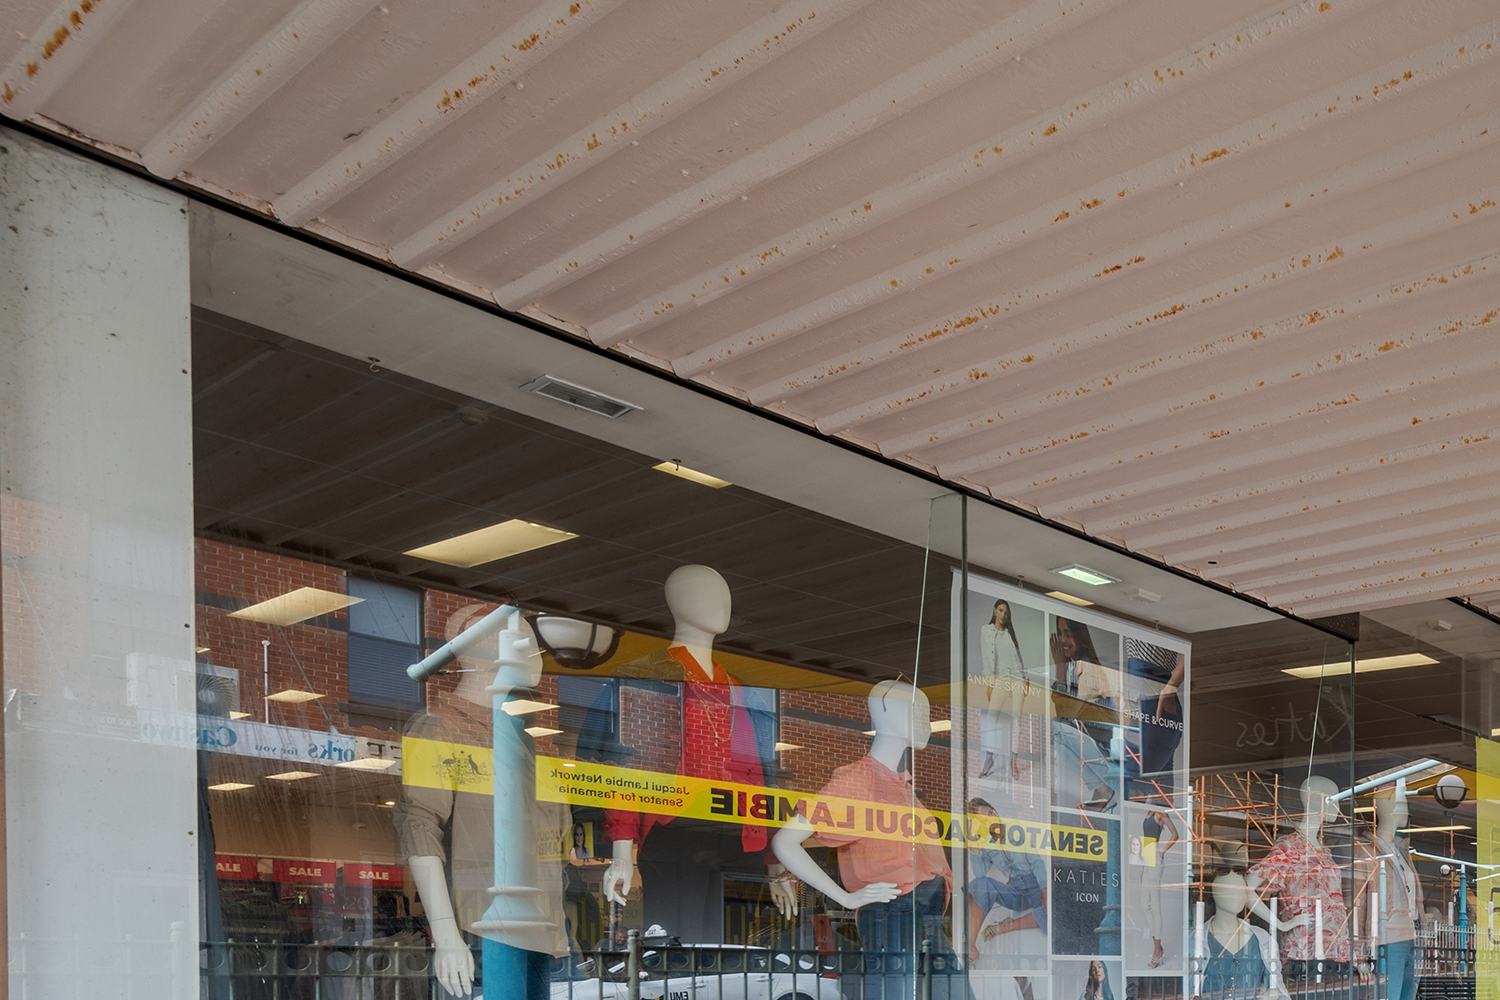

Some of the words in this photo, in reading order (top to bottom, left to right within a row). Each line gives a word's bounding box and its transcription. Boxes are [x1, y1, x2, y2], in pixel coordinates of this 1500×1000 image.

[967, 673, 1001, 690] ANKLE
[1004, 681, 1042, 698] SKINNY
[1123, 709, 1150, 724] SHAPE
[1158, 716, 1184, 732] CURVE
[215, 863, 241, 873] ALE
[289, 866, 322, 877] SALE
[359, 870, 390, 881] SALE
[1053, 868, 1120, 888] KATIES
[1076, 892, 1099, 903] ICON
